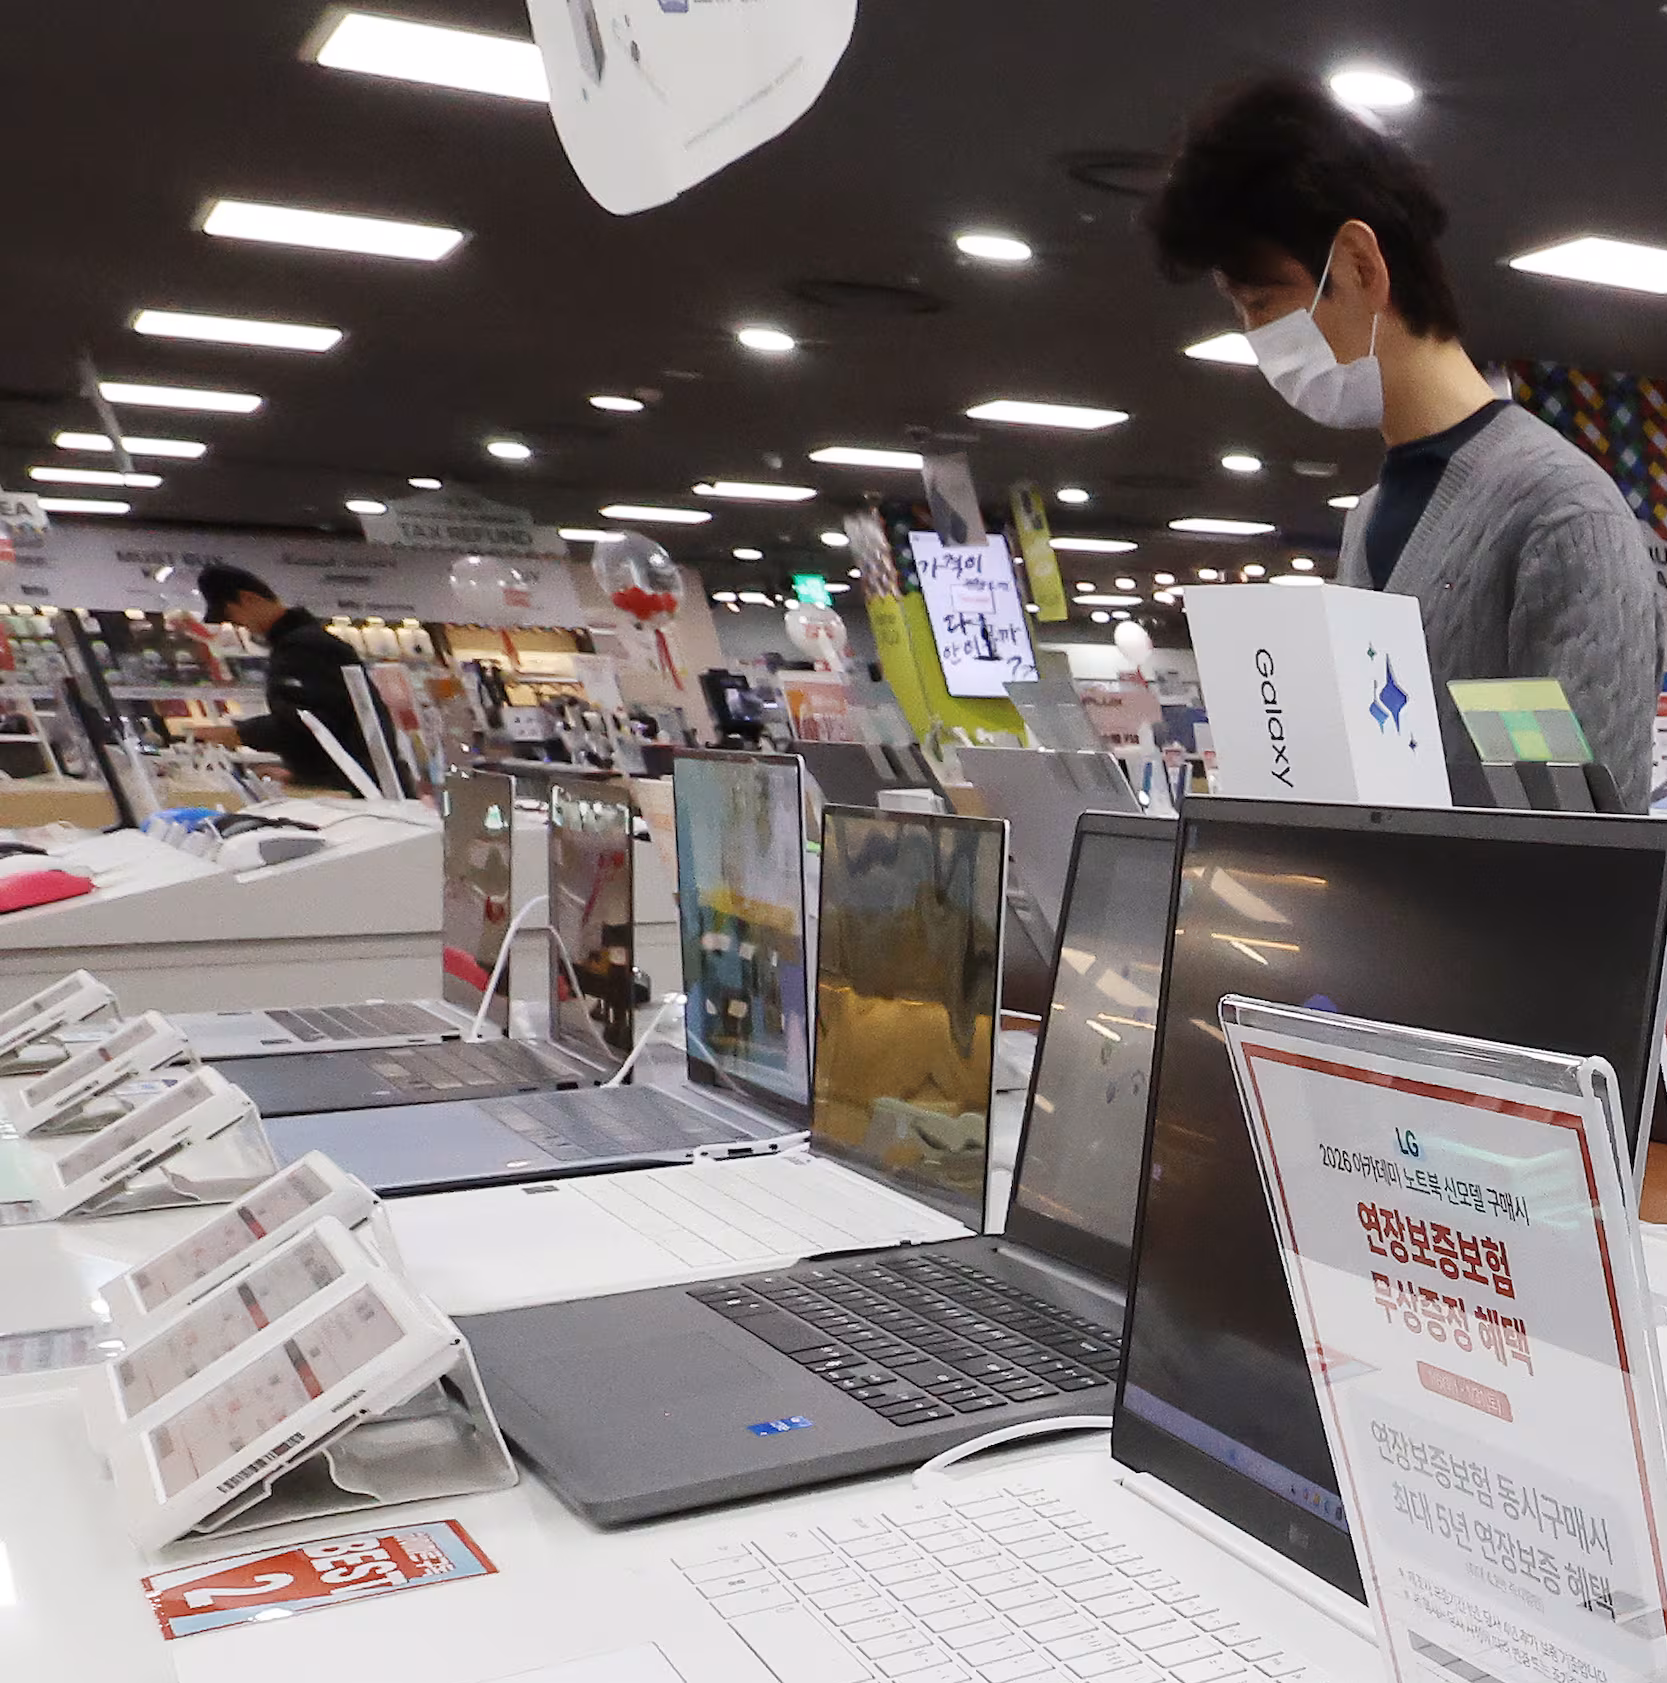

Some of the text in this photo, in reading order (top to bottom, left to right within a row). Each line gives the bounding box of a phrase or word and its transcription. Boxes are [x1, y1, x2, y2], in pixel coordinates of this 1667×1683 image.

[1255, 647, 1293, 789] Galaxy
[1320, 1144, 1530, 1226] 2026 아카데미 노트북 신모델 구매시
[1395, 1127, 1419, 1157] LG
[1357, 1201, 1516, 1299] 연장보증보험
[1371, 1270, 1534, 1377] 무상증정 혜택
[1371, 1420, 1613, 1565] 연장보증보험 동시구매시
[183, 1573, 296, 1610] 2
[302, 1537, 409, 1596] BEST
[1392, 1480, 1434, 1534] 최대
[1435, 1502, 1472, 1552] 5년
[1474, 1520, 1561, 1596] 연장보증
[1564, 1562, 1616, 1624] 혜택
